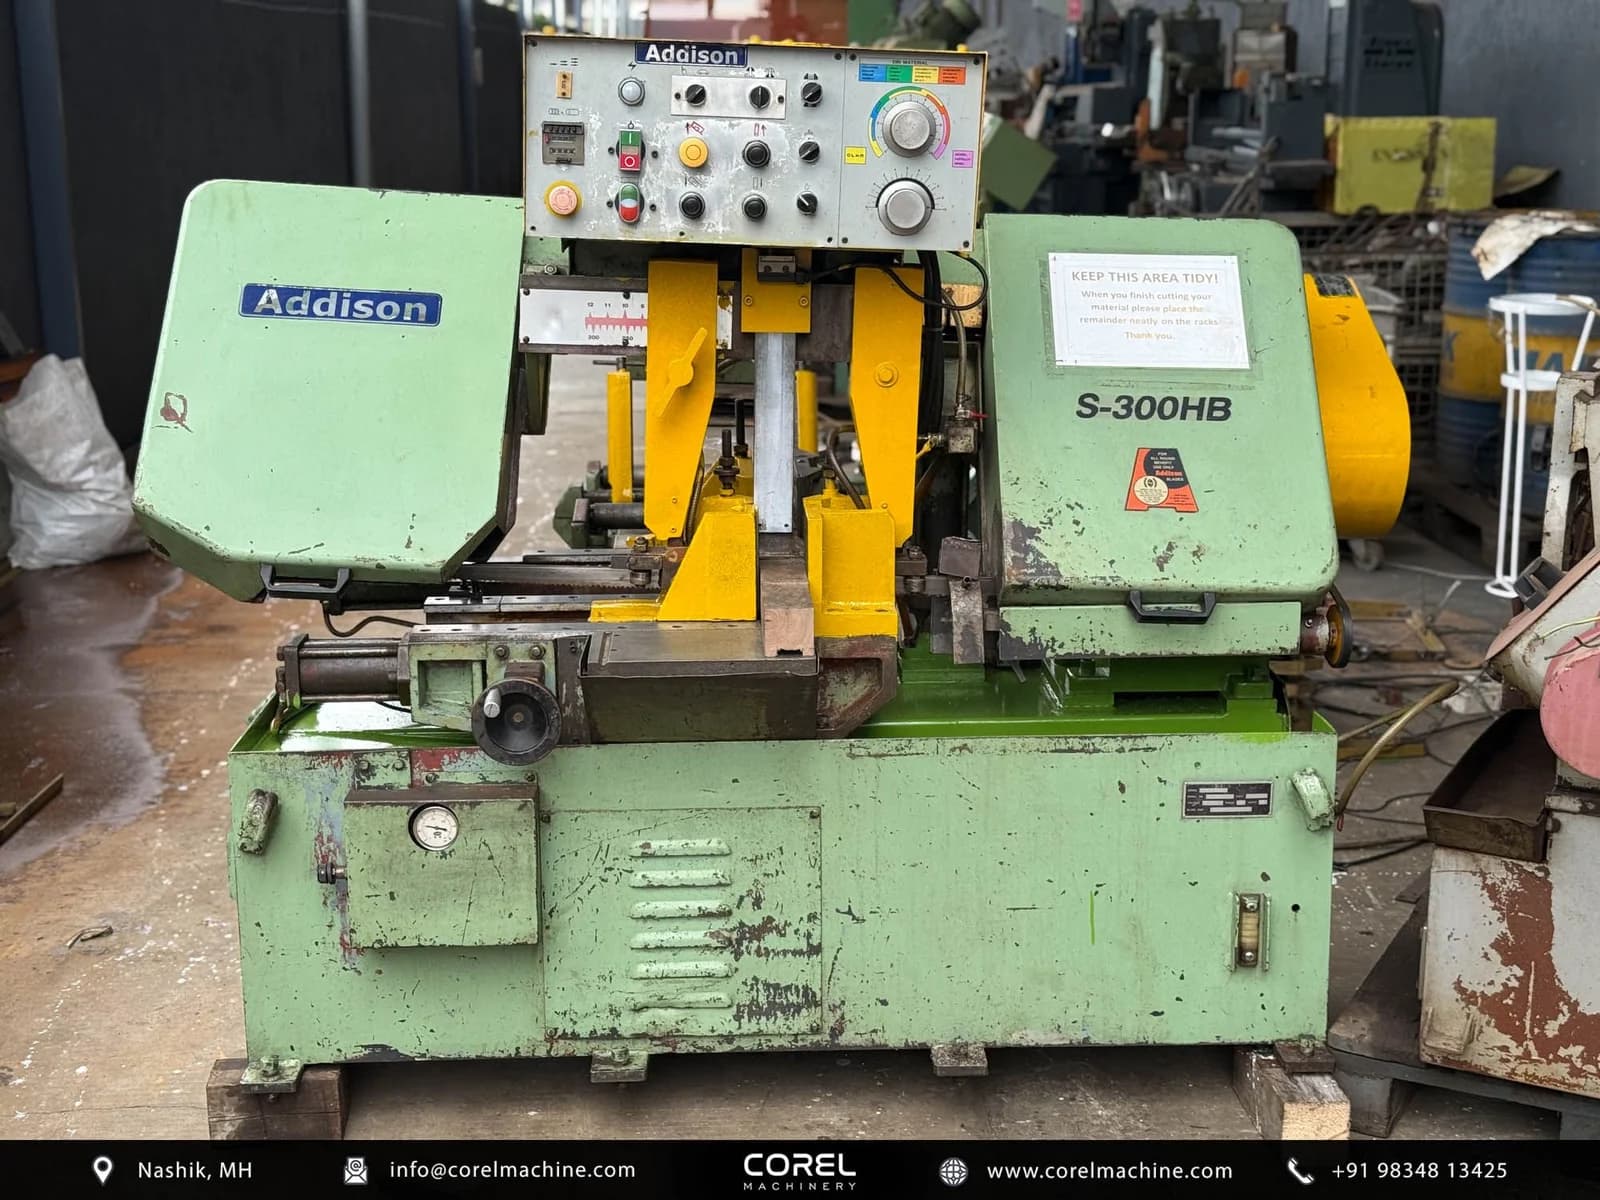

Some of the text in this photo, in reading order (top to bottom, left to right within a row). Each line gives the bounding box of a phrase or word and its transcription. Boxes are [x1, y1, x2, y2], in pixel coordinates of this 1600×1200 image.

[645, 44, 738, 65] Addison
[1072, 271, 1219, 284] KEEP THIS AREA TIDY!
[1081, 290, 1212, 302] When you finish cutting your
[253, 288, 427, 321] Addison
[1091, 304, 1129, 312] material
[1131, 304, 1160, 314] please
[1163, 305, 1187, 314] place
[1080, 317, 1126, 325] remainder
[1129, 317, 1158, 327] neatly
[1176, 318, 1190, 326] the
[1125, 332, 1152, 340] Thank
[1076, 393, 1232, 421] S-300HB
